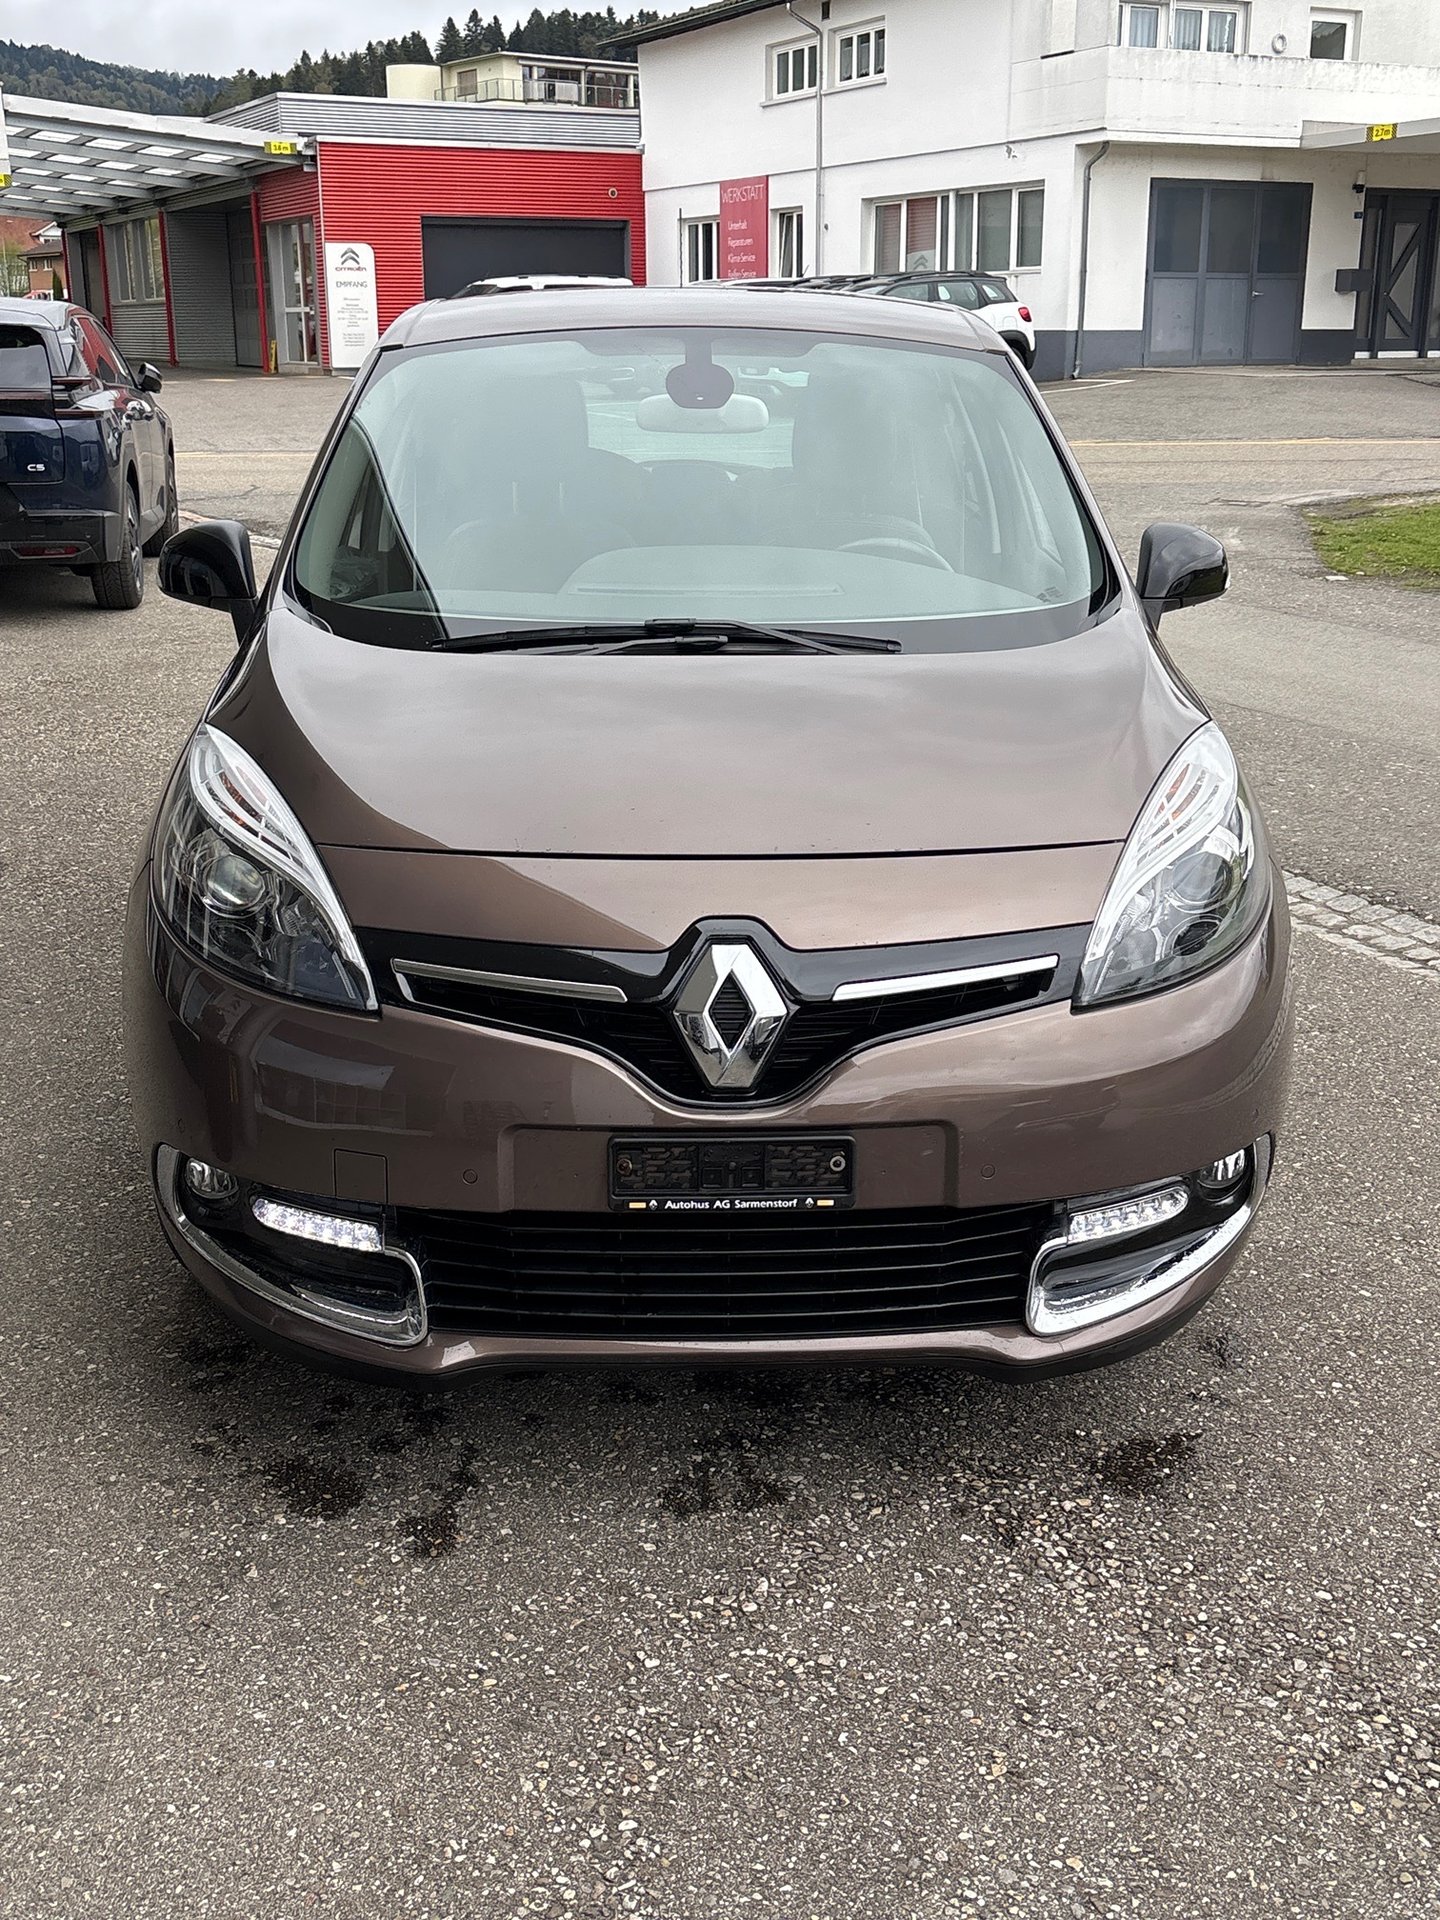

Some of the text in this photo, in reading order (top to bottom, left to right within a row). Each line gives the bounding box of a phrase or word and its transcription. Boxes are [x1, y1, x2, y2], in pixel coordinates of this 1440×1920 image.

[721, 184, 764, 203] WERKSTATT
[27, 463, 46, 472] C5
[664, 1199, 798, 1209] Autohus AG Sarmenstorf
